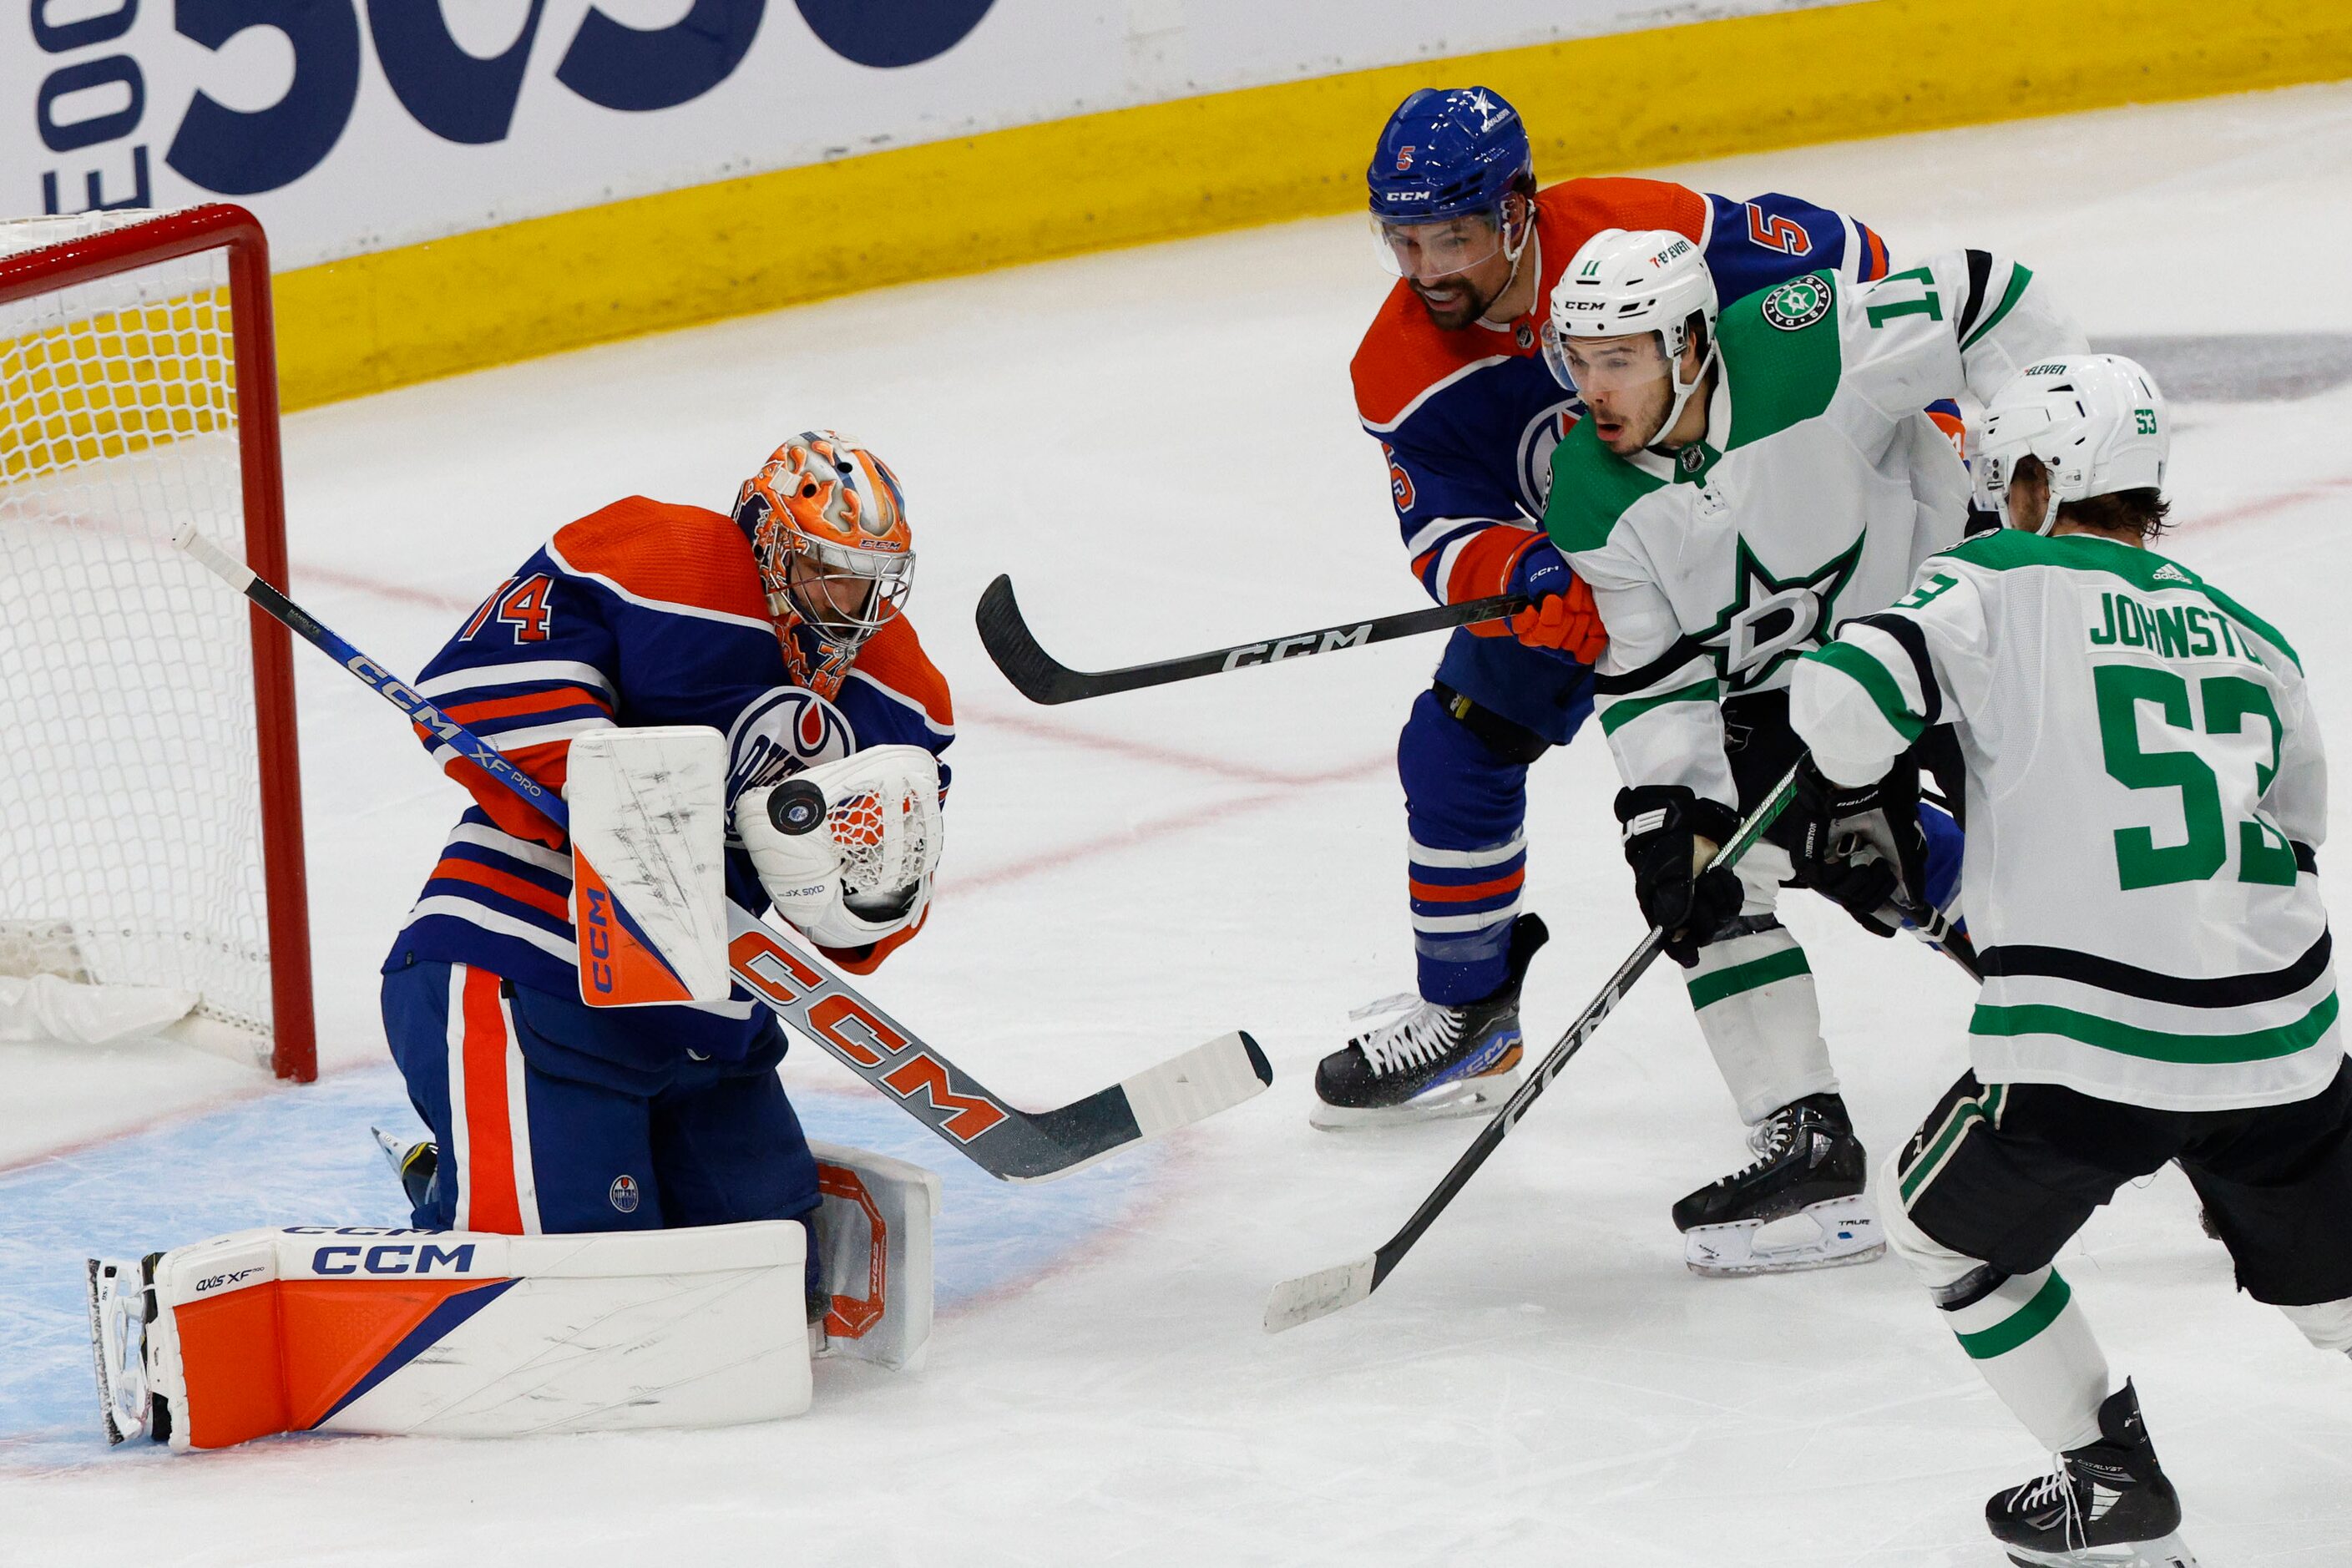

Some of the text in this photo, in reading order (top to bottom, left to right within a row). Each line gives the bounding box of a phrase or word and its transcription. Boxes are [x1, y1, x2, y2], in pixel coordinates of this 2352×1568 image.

[1397, 146, 1415, 170] 5
[1387, 191, 1430, 200] CCM
[1745, 202, 1813, 256] 5
[1581, 260, 1601, 276] 11
[1565, 301, 1606, 310] CCM
[2135, 409, 2157, 434] 53
[860, 539, 902, 550] CCM
[1530, 565, 1560, 582] CCM
[1222, 624, 1373, 672] CCM
[347, 655, 463, 741] CCM
[469, 743, 511, 774] XF
[511, 771, 542, 797] PRO
[2093, 665, 2297, 890] 53
[1805, 822, 1818, 859] JOHNSTON
[587, 887, 613, 994] CCM
[729, 931, 1011, 1145] CCM
[1504, 986, 1620, 1137] CCM
[281, 1227, 449, 1236] CCM
[312, 1244, 476, 1275] CCM
[2077, 1459, 2123, 1472] CATALYST
